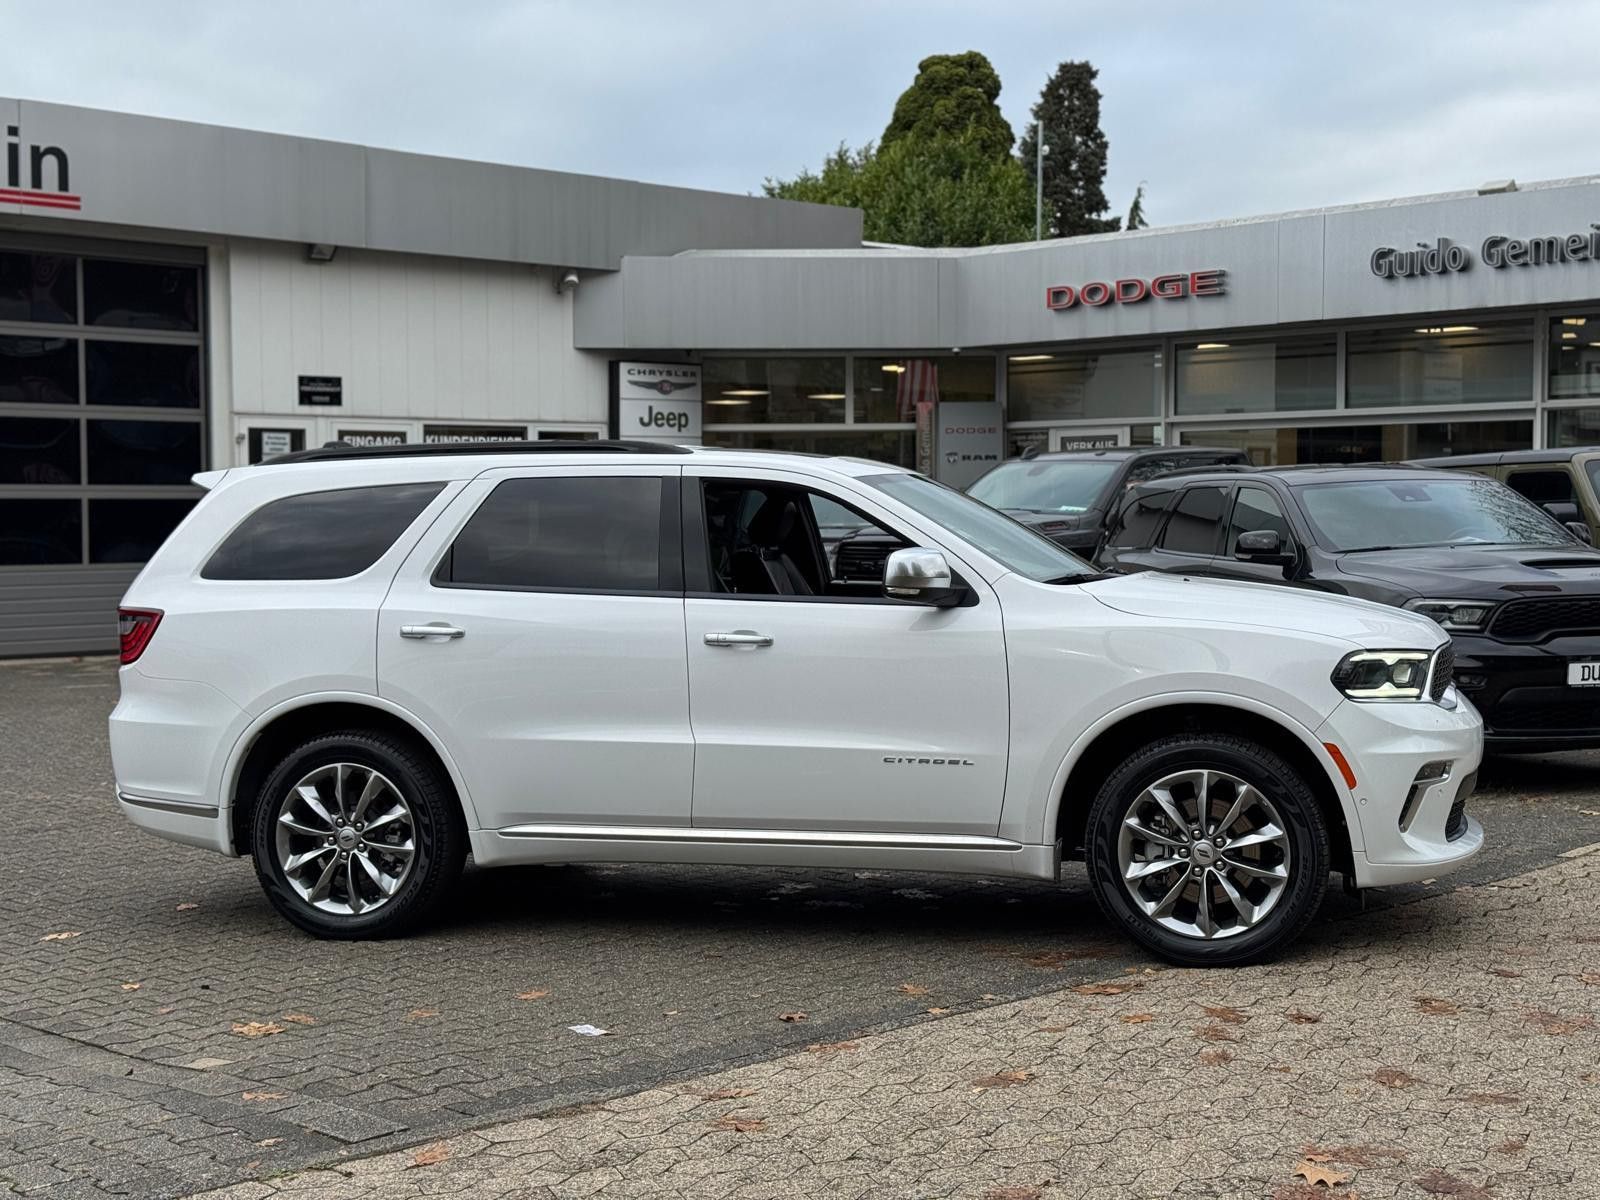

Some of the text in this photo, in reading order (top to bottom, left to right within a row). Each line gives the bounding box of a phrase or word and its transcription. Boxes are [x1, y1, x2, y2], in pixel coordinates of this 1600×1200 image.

[7, 125, 70, 192] in
[1370, 237, 1470, 278] Guido
[1046, 269, 1226, 311] DODGE
[627, 368, 697, 378] CHRYSLER
[638, 405, 690, 433] Jeep
[944, 426, 997, 435] DODGE
[343, 434, 401, 448] EINGANG
[1066, 440, 1116, 451] VERKAUF
[961, 453, 998, 461] RAM
